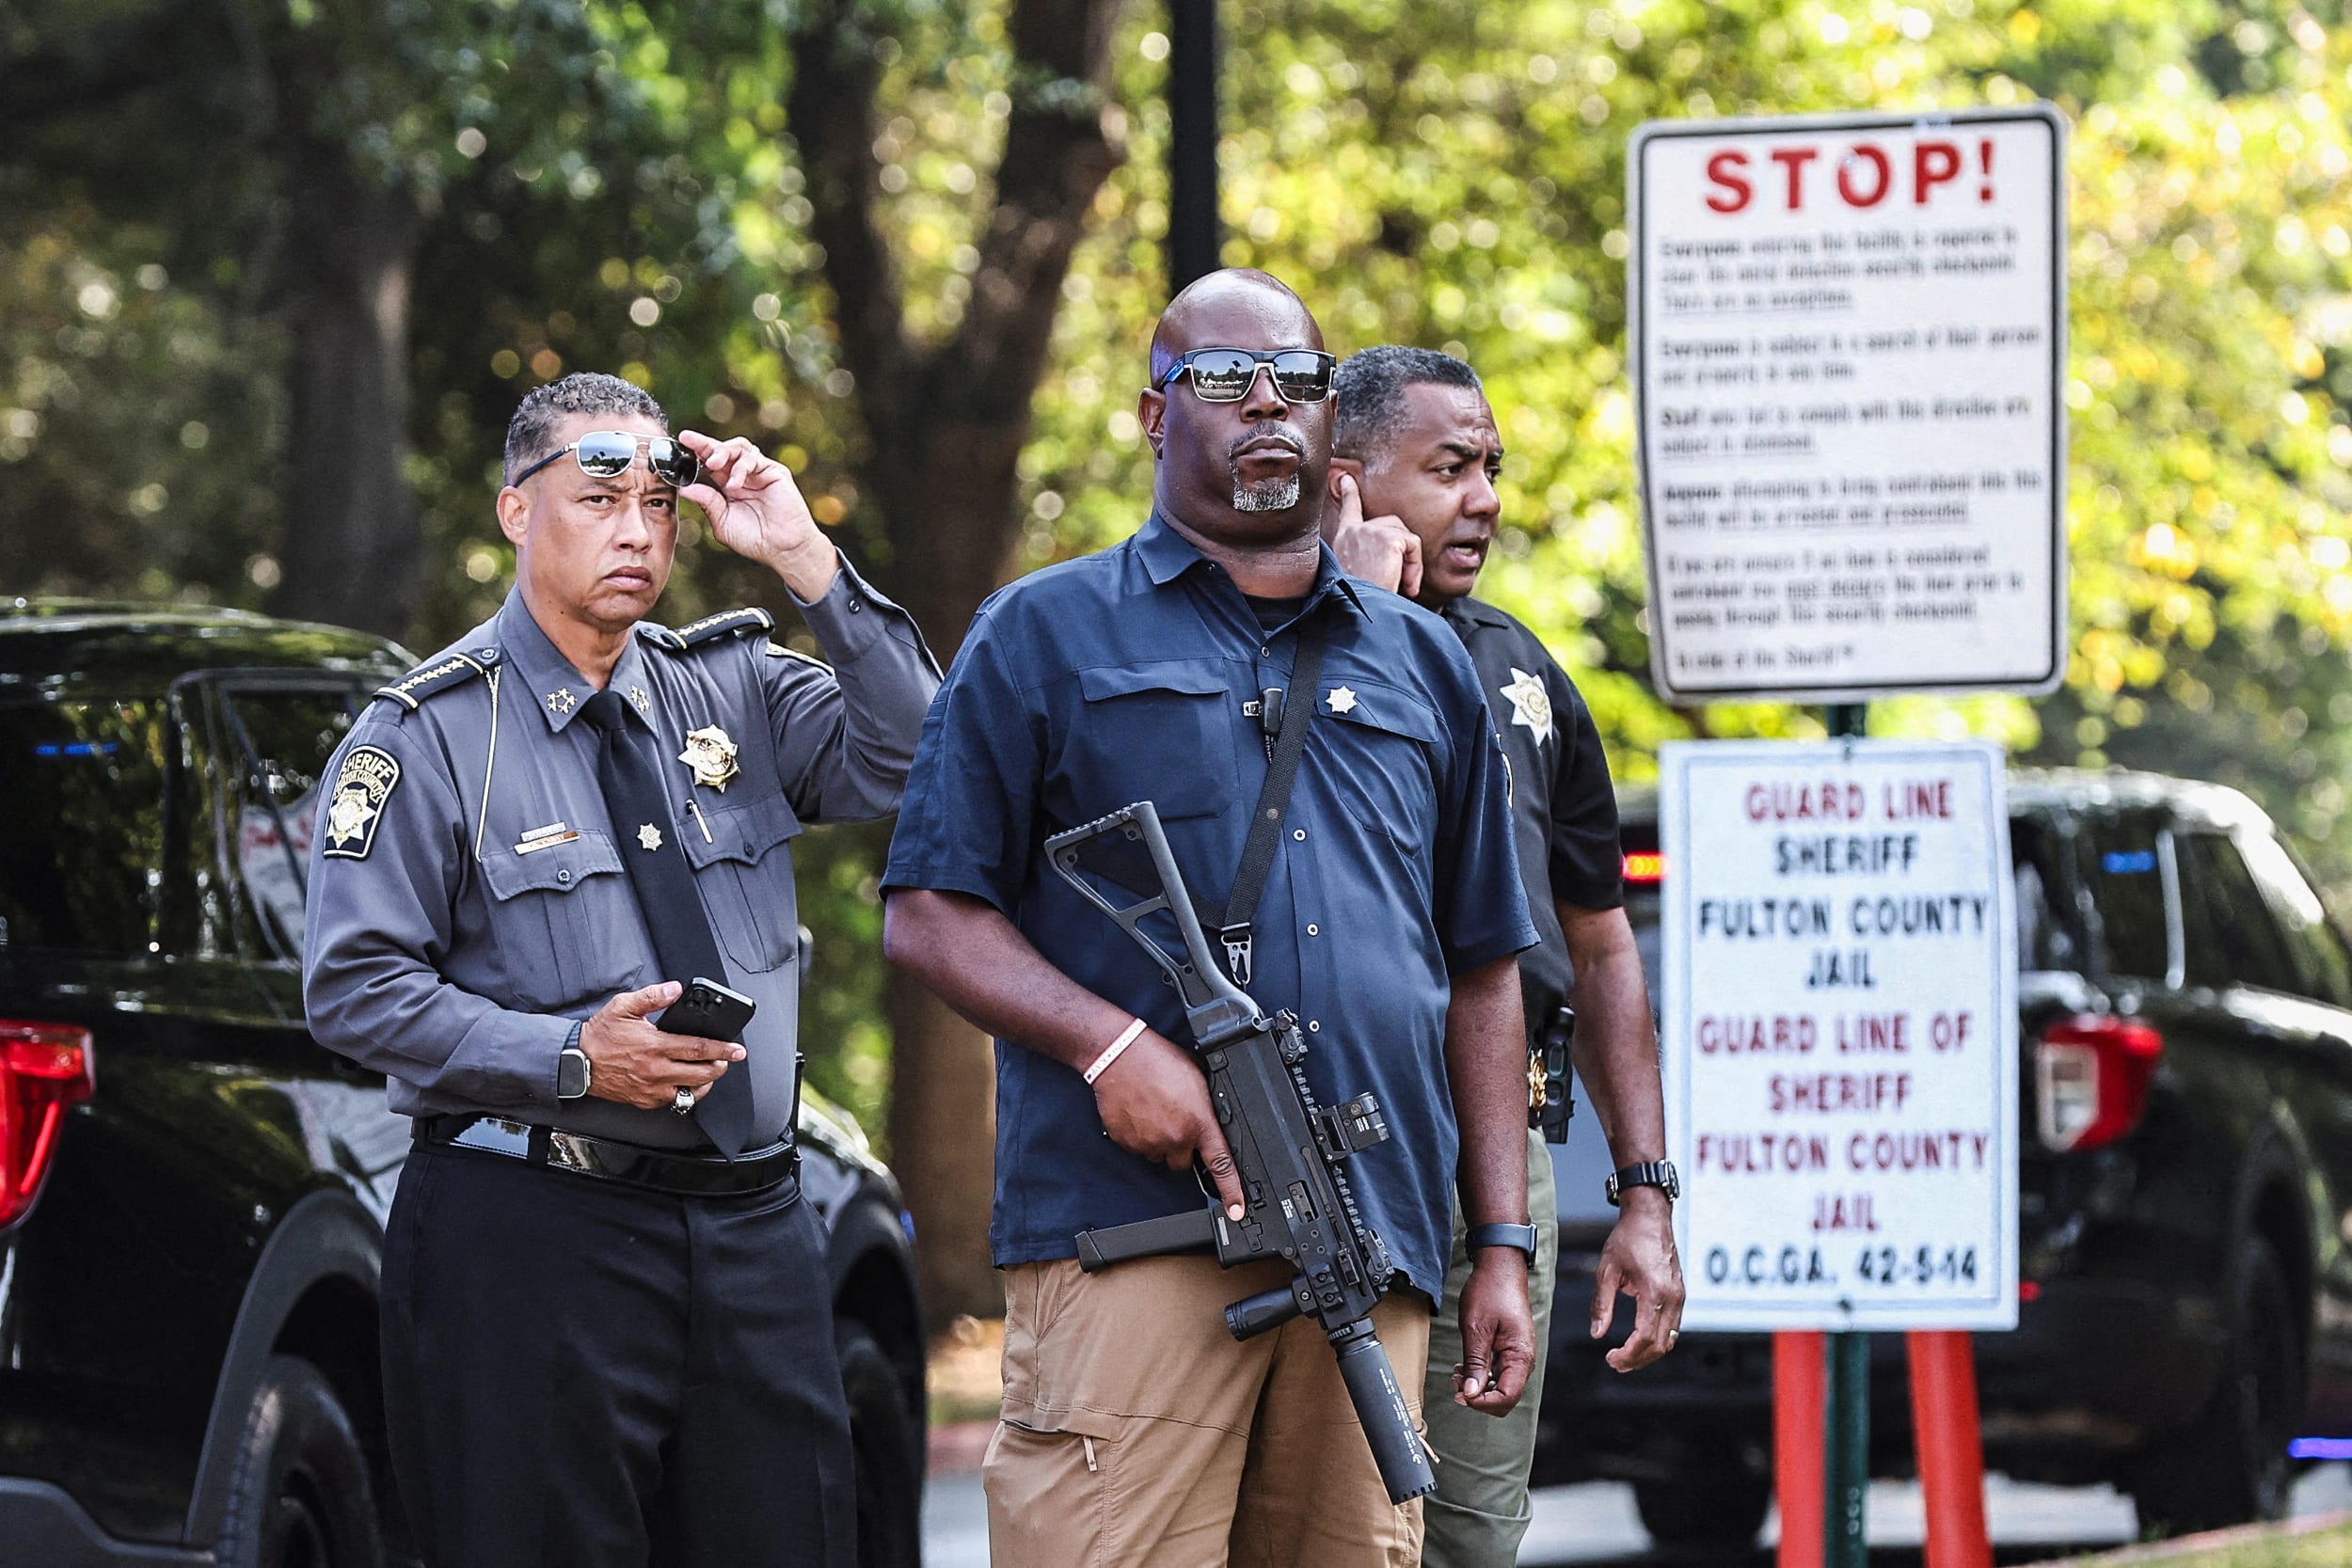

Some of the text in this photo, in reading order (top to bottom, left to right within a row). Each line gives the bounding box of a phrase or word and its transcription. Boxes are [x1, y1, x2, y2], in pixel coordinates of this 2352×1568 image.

[1706, 140, 1994, 214] STOP!
[342, 753, 394, 779] SHERIFF
[1747, 781, 1953, 821] GUARD LINE
[1776, 834, 1917, 874] SHERIFF
[1700, 896, 1987, 936] FULTON COUNTY
[1806, 948, 1874, 988] JAIL
[1698, 1012, 1971, 1054] GUARD LINE OF
[1770, 1074, 1911, 1112] SHERIFF
[1697, 1132, 1987, 1172] FULTON COUNTY
[1812, 1193, 1879, 1231] JAIL
[1857, 1244, 1977, 1285] 42-5-14
